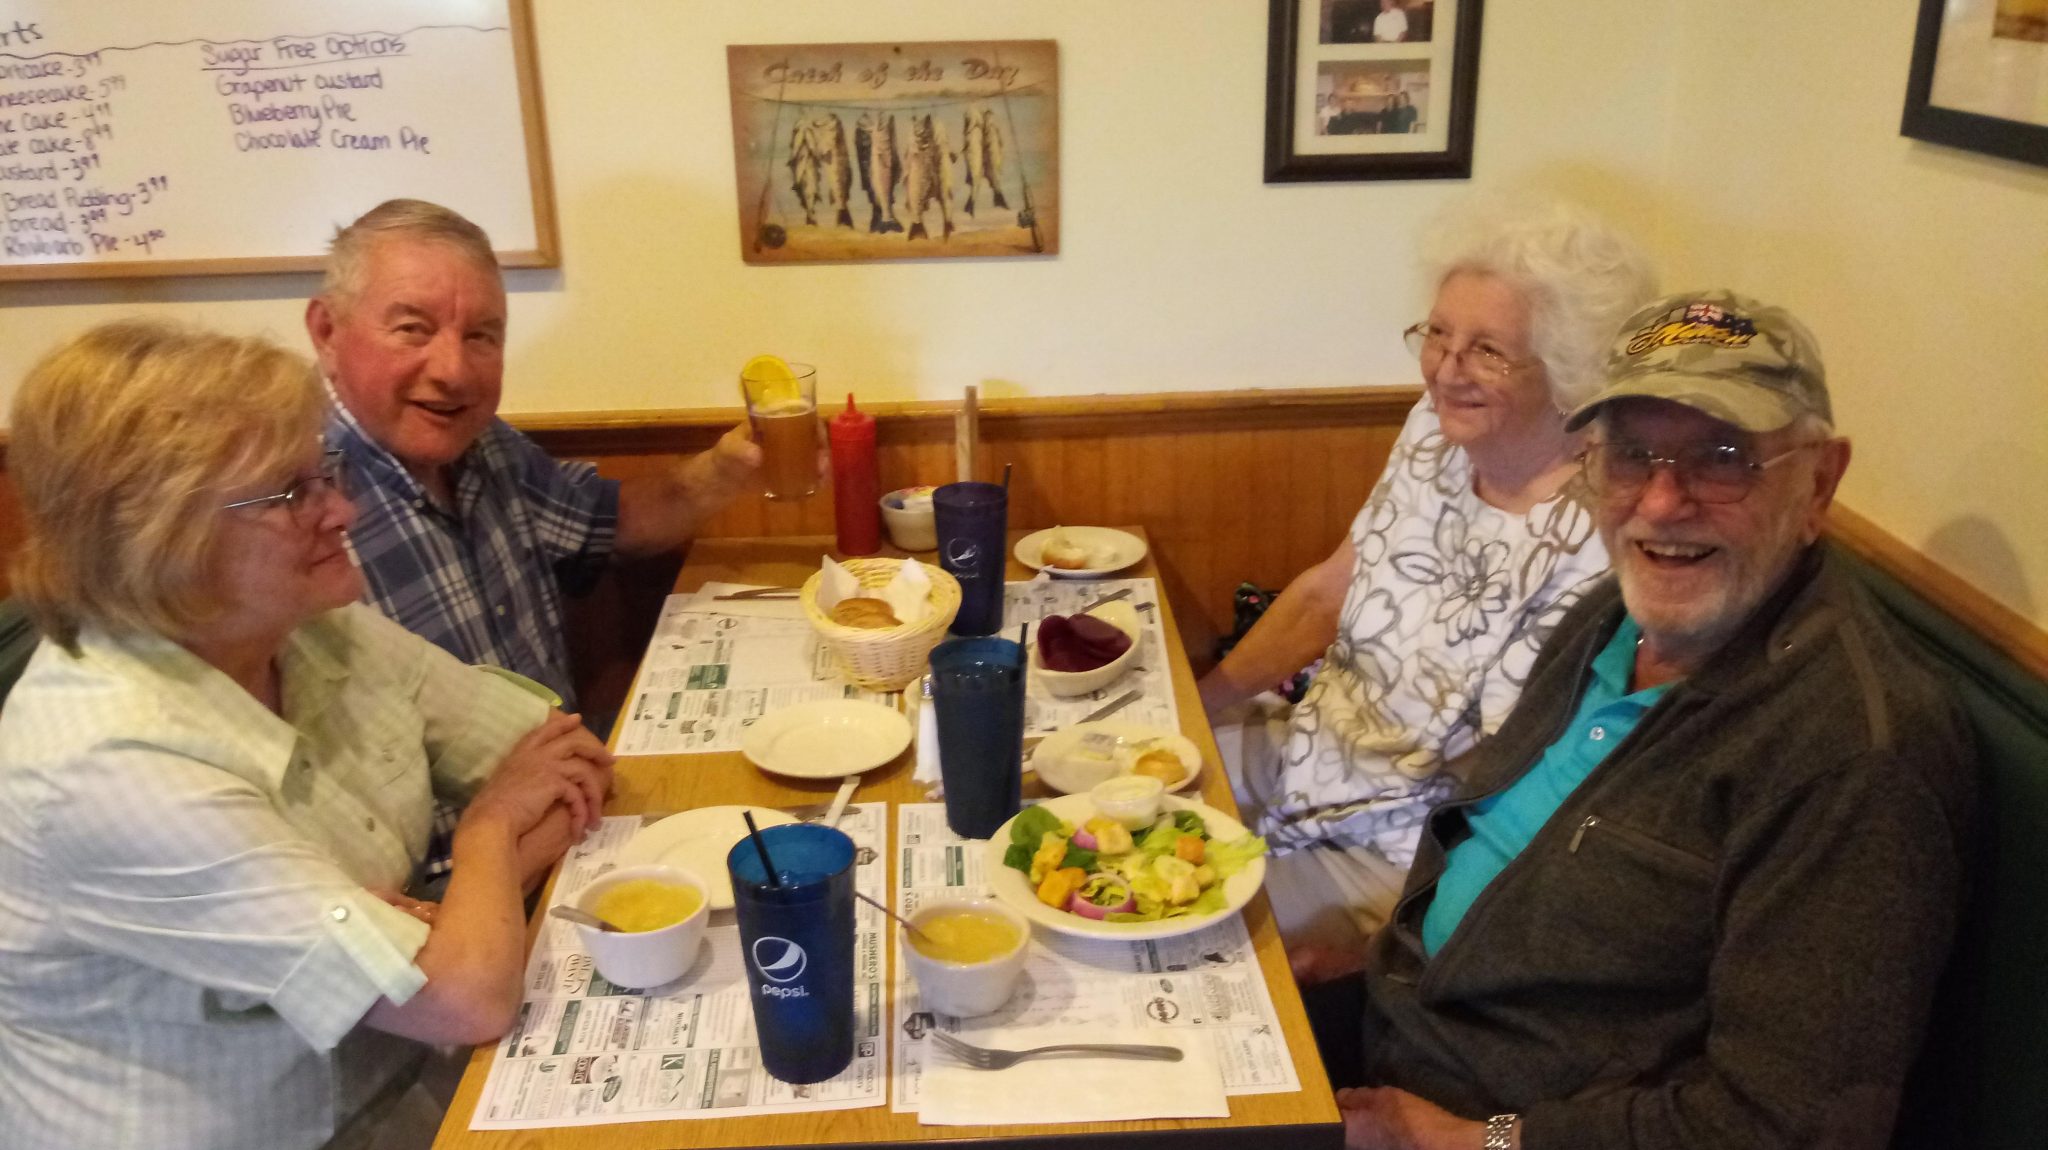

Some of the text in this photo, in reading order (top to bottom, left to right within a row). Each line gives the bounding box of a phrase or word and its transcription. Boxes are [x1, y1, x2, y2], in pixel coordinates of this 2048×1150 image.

[201, 36, 406, 76] Sugar Free Options
[763, 57, 1022, 90] Catch of the Day
[229, 95, 357, 129] Blueberry Pie
[235, 126, 431, 154] Chocolate Cream Pie
[3, 192, 57, 212] Bread
[89, 233, 118, 254] Pie
[761, 984, 806, 1000] pepsi
